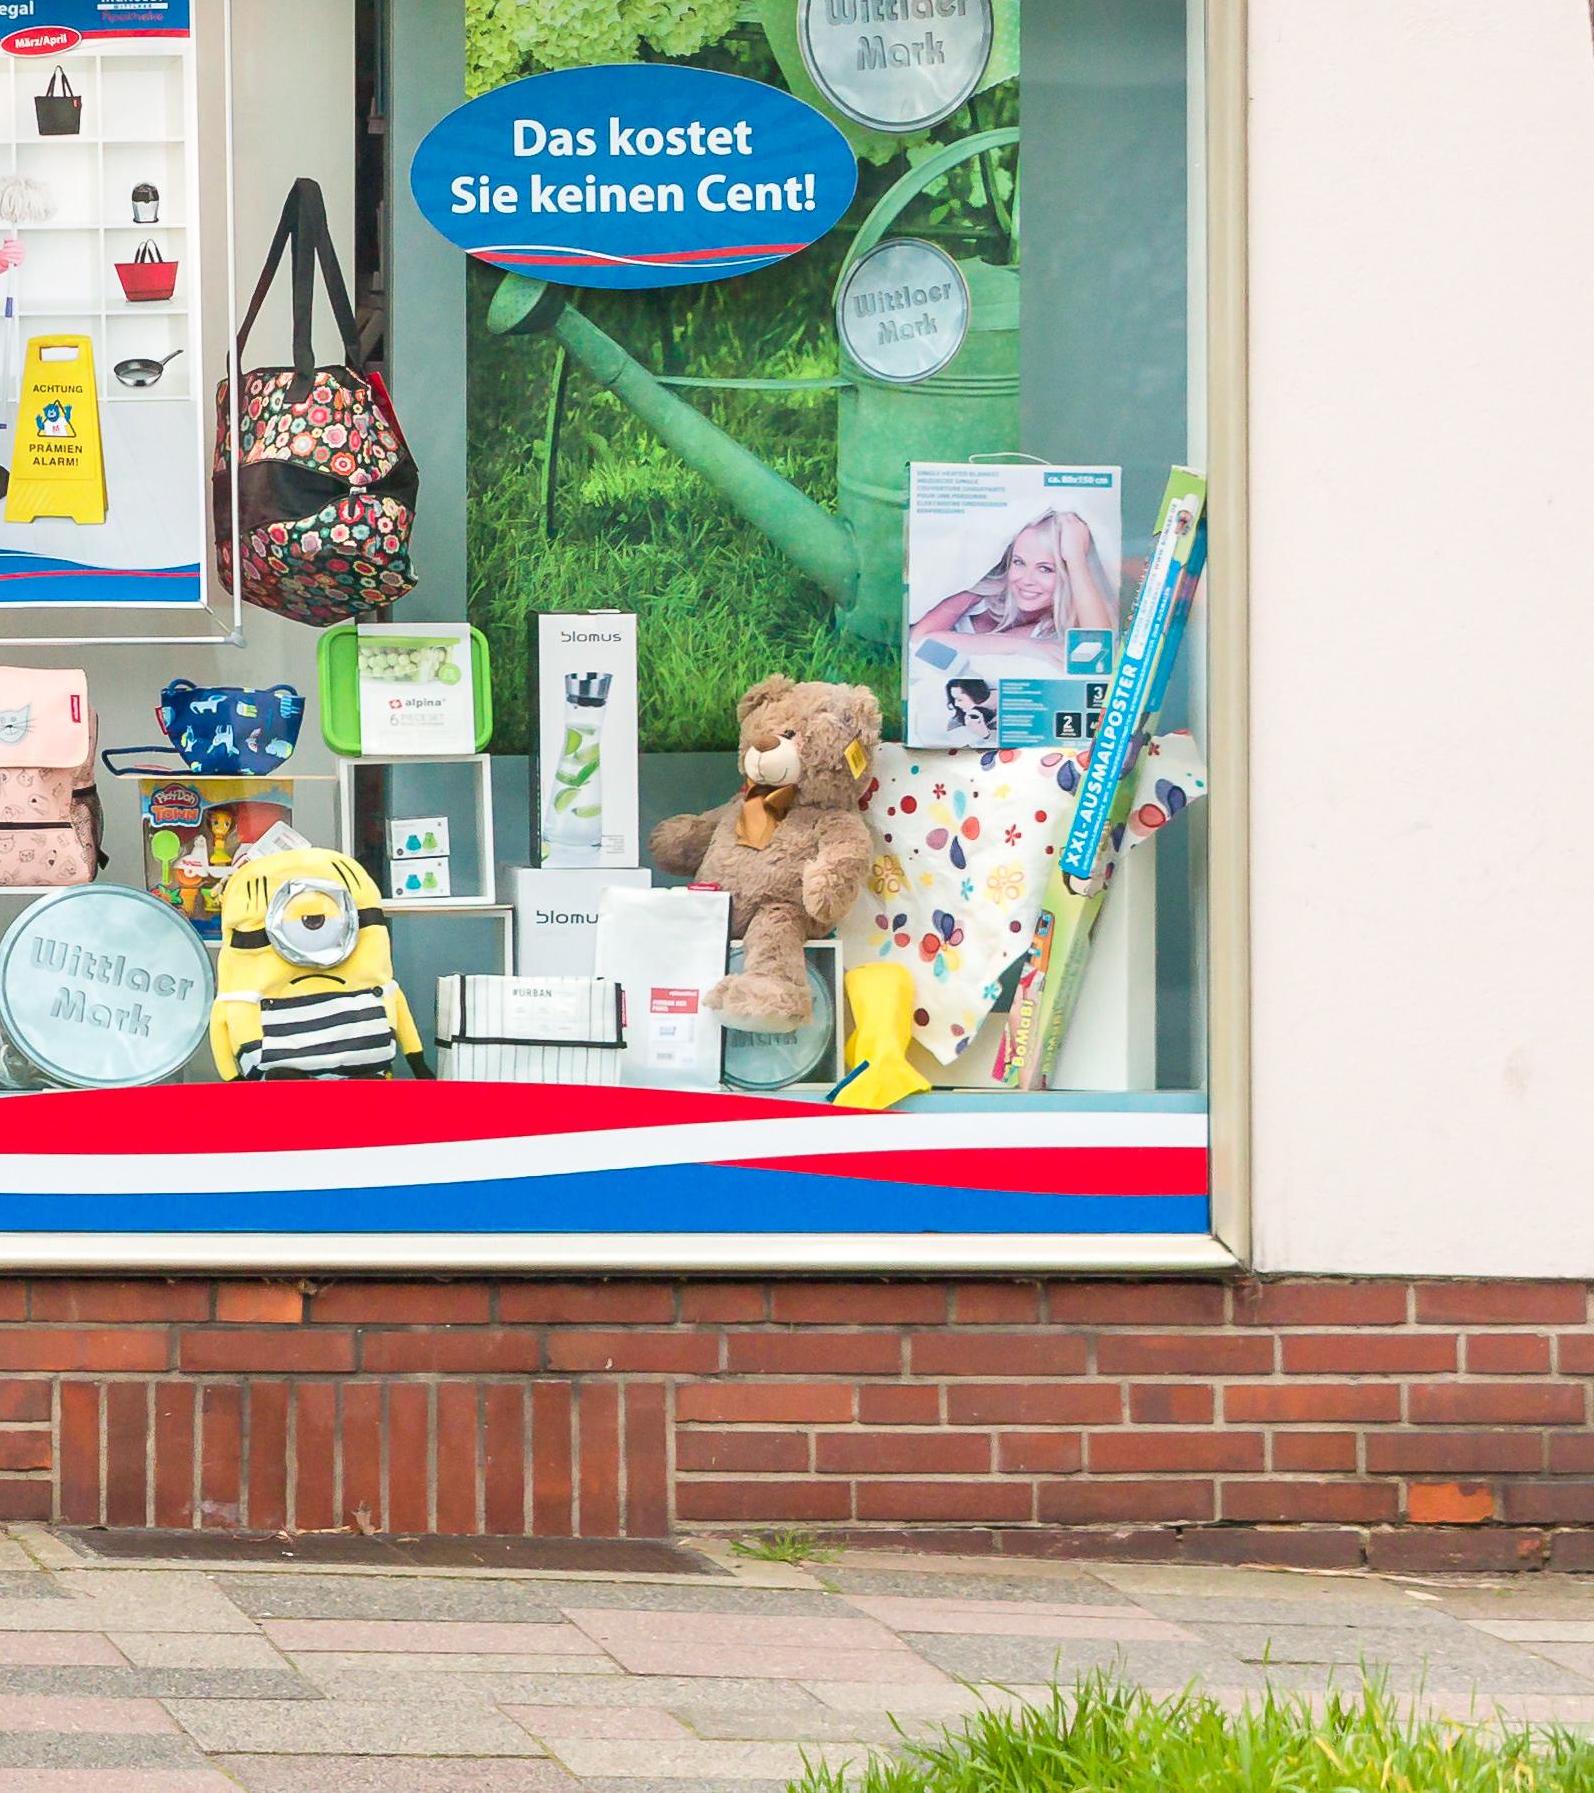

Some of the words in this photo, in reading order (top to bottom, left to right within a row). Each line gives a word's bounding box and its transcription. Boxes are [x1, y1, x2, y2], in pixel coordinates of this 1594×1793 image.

[14, 32, 68, 49] März/April
[856, 32, 946, 72] Mark
[512, 118, 597, 159] Das
[608, 116, 752, 159] kostet
[451, 174, 519, 215] Sie
[529, 174, 688, 214] keinen
[697, 173, 817, 214] Cent!
[852, 280, 952, 319] Wittlaer
[877, 312, 938, 346] Mark
[32, 384, 83, 394] ACHTUNG
[28, 443, 83, 454] PRÄMIEN
[32, 456, 79, 467] ALARM!
[561, 631, 623, 643] blomus
[1093, 686, 1104, 700] 3
[404, 697, 442, 710] alpina
[389, 713, 400, 727] 6
[1063, 716, 1073, 729] 2
[1063, 662, 1139, 871] XXL-AUSMALPOSTER
[150, 804, 202, 825] TOWN
[30, 935, 195, 1002] Wittlaer
[50, 986, 153, 1038] Mark
